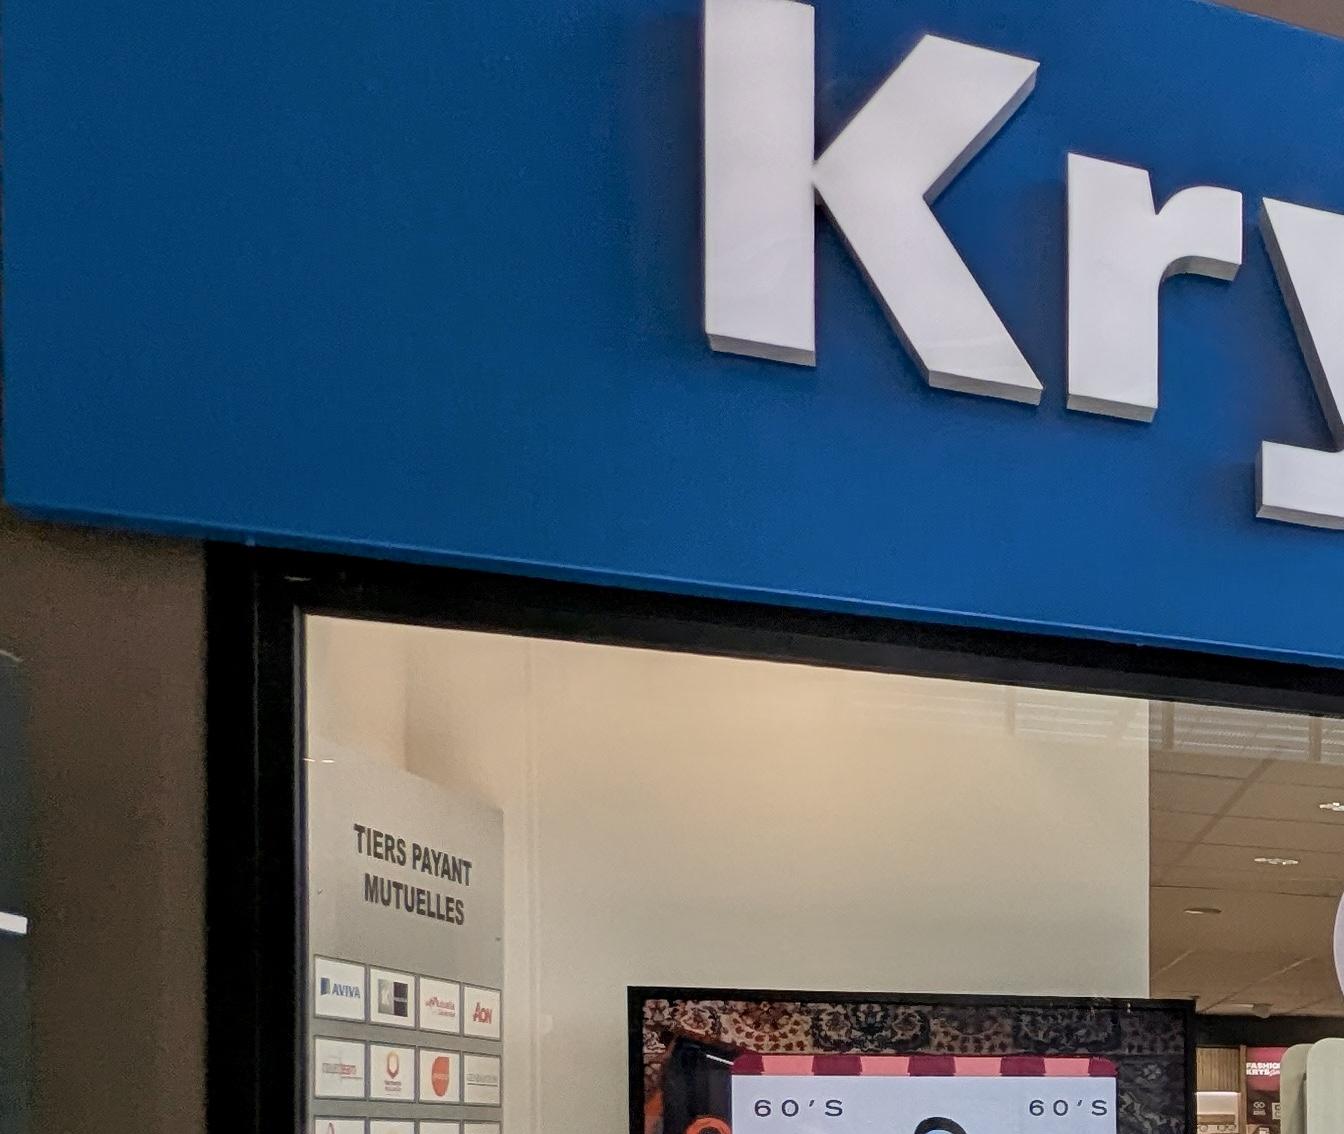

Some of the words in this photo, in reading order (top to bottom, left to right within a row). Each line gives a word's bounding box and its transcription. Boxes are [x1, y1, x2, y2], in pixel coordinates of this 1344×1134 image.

[353, 823, 407, 866] TIERS
[412, 843, 473, 887] PAYANT
[364, 872, 465, 926] MUTUELLES
[332, 983, 361, 999] AVIVA
[754, 1099, 843, 1118] 60'S
[1029, 1099, 1108, 1117] 60'S
